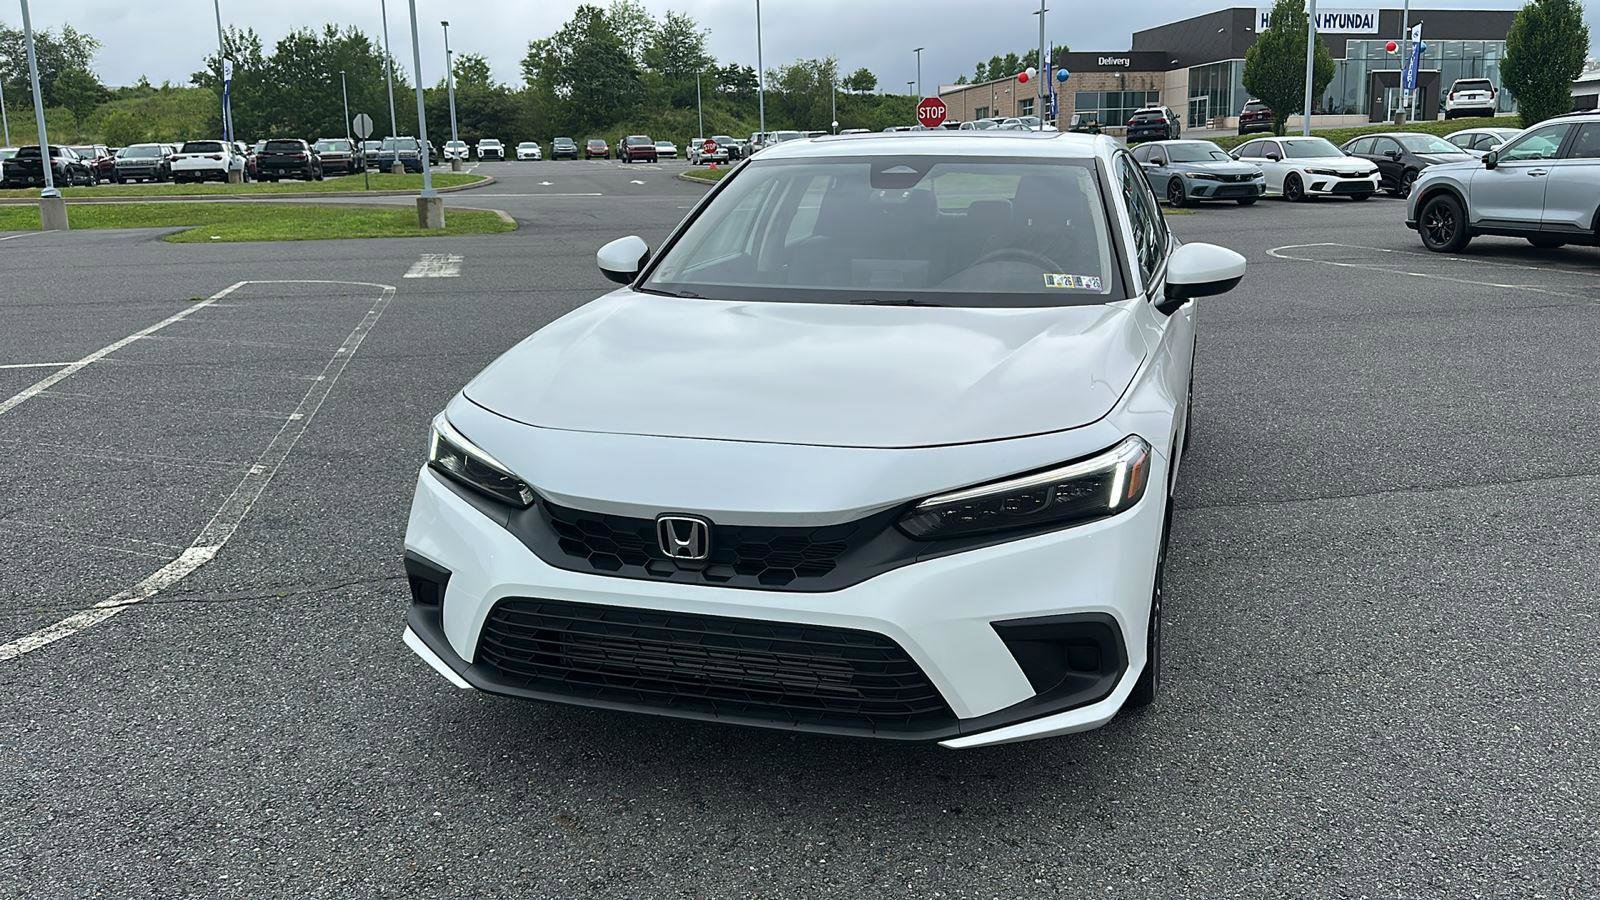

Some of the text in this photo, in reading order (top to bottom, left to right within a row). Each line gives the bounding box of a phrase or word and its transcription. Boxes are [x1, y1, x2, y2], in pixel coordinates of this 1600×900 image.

[1323, 13, 1374, 29] HYUNDAI
[1098, 56, 1130, 67] Delivery
[919, 106, 945, 119] STOP
[703, 143, 717, 151] STOP
